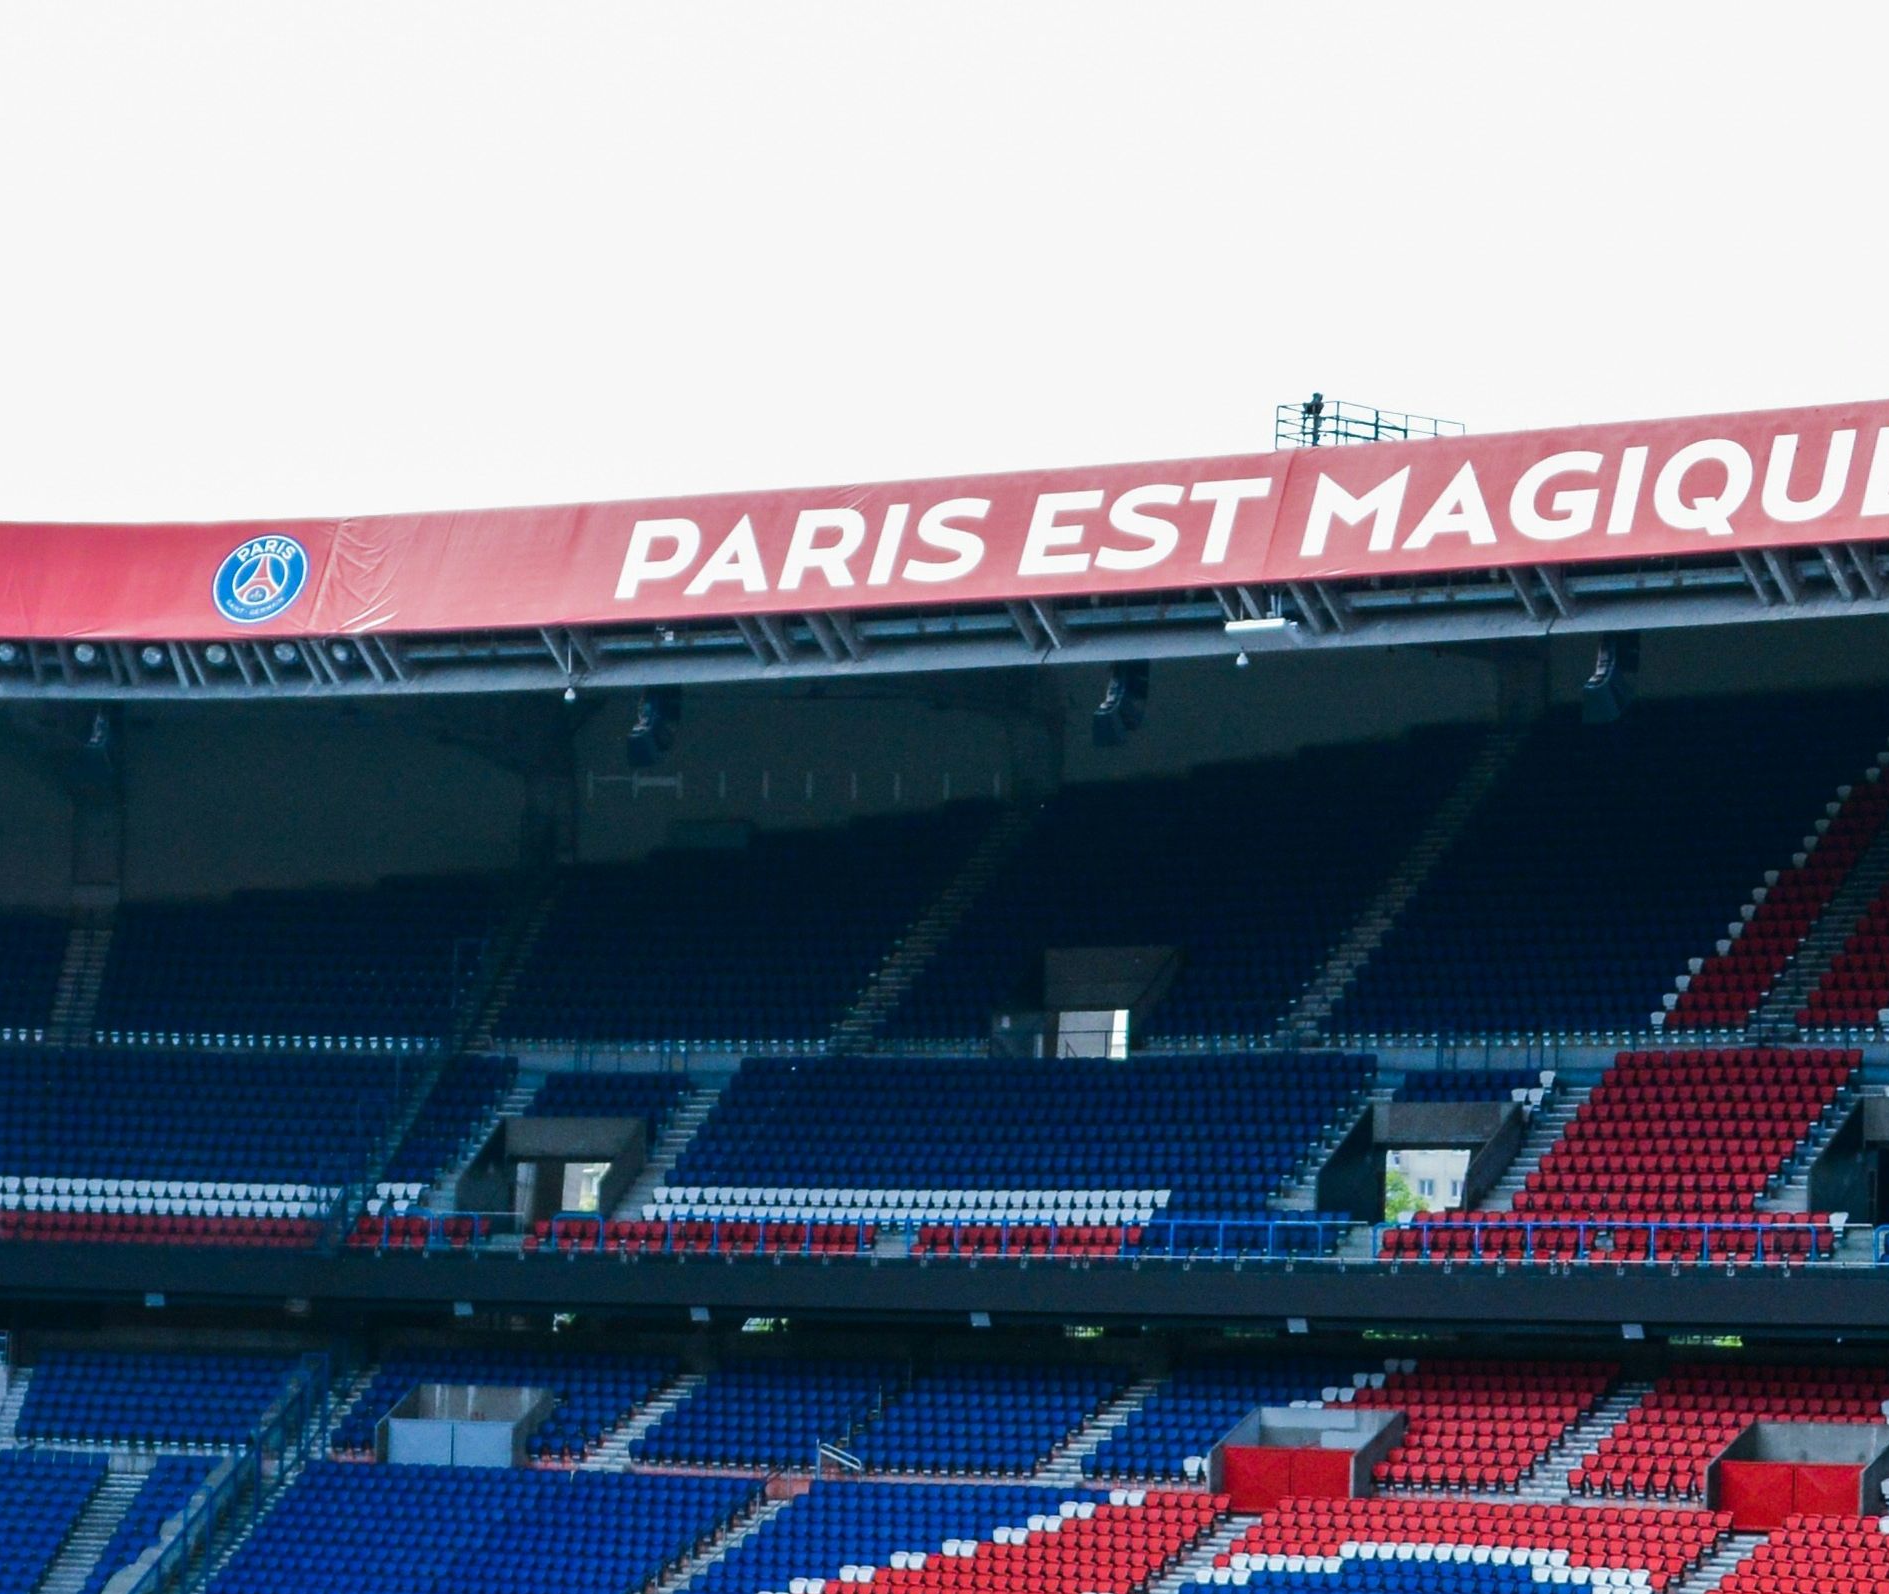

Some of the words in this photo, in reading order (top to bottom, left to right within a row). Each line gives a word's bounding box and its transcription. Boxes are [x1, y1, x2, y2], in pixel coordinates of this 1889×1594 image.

[236, 539, 296, 562] PARIS
[613, 497, 992, 600] PARIS
[1016, 476, 1273, 576] EST
